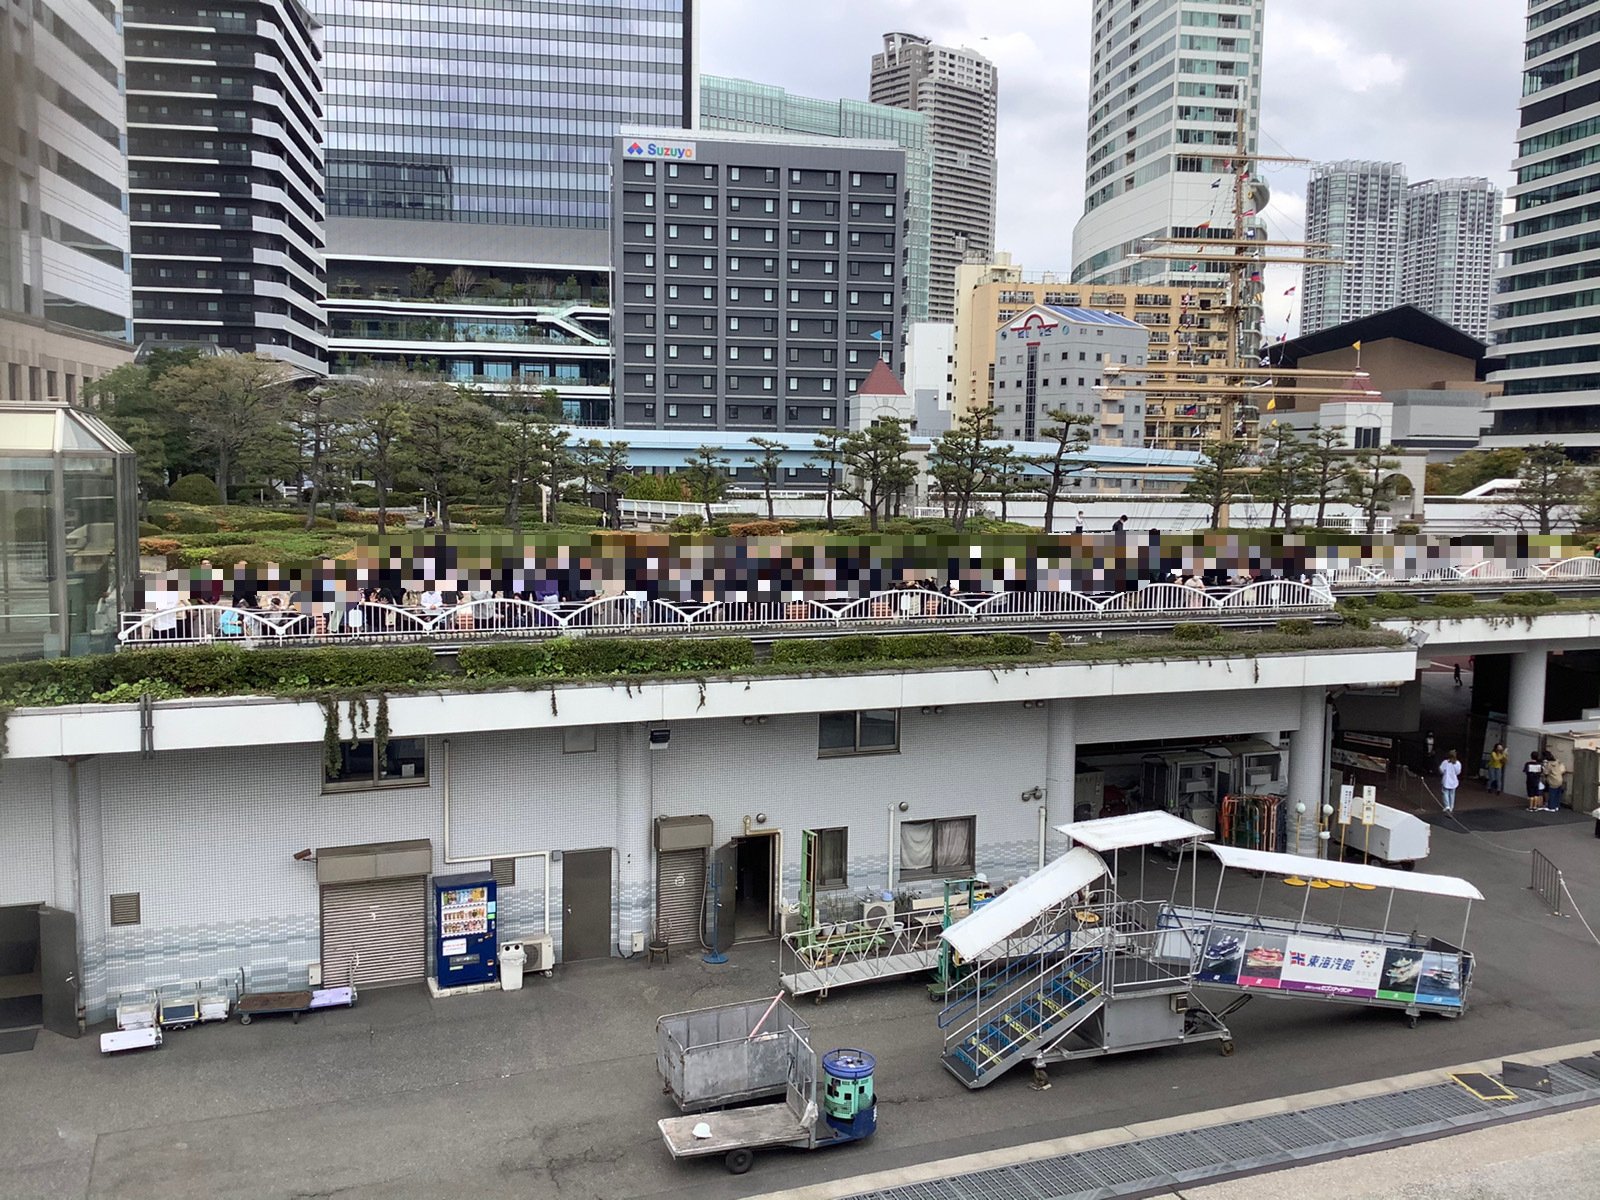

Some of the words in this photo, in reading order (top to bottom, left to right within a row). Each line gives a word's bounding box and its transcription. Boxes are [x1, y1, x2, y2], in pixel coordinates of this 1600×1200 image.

[647, 143, 692, 158] Suzuyo
[1307, 955, 1355, 971] 東海汽船
